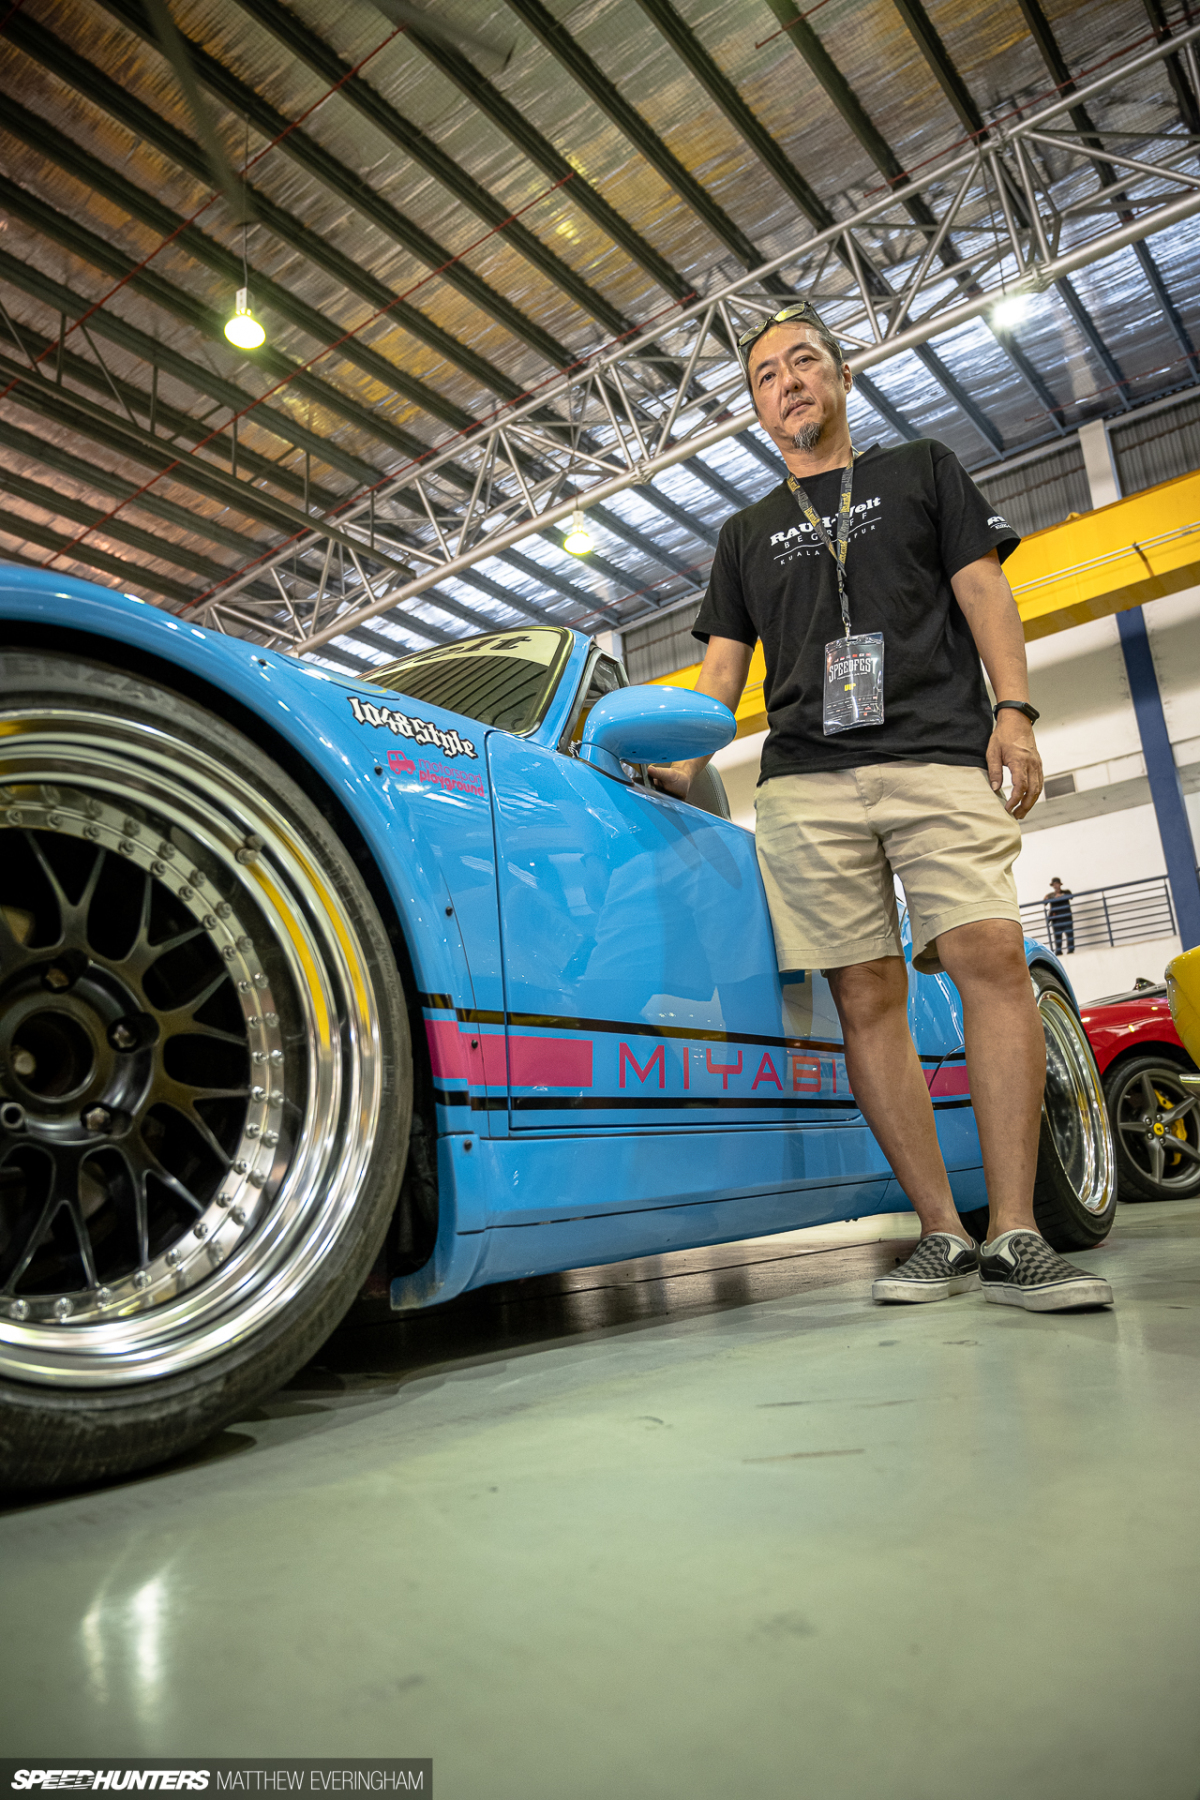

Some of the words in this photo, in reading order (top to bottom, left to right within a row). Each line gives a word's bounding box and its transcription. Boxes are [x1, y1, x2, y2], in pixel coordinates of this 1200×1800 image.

[784, 512, 867, 549] BEGRFF
[780, 550, 820, 566] KUALA
[828, 657, 879, 683] SPEEDFEST
[418, 758, 482, 786] motorsport
[419, 769, 485, 797] playground
[618, 1041, 837, 1094] MIYABI
